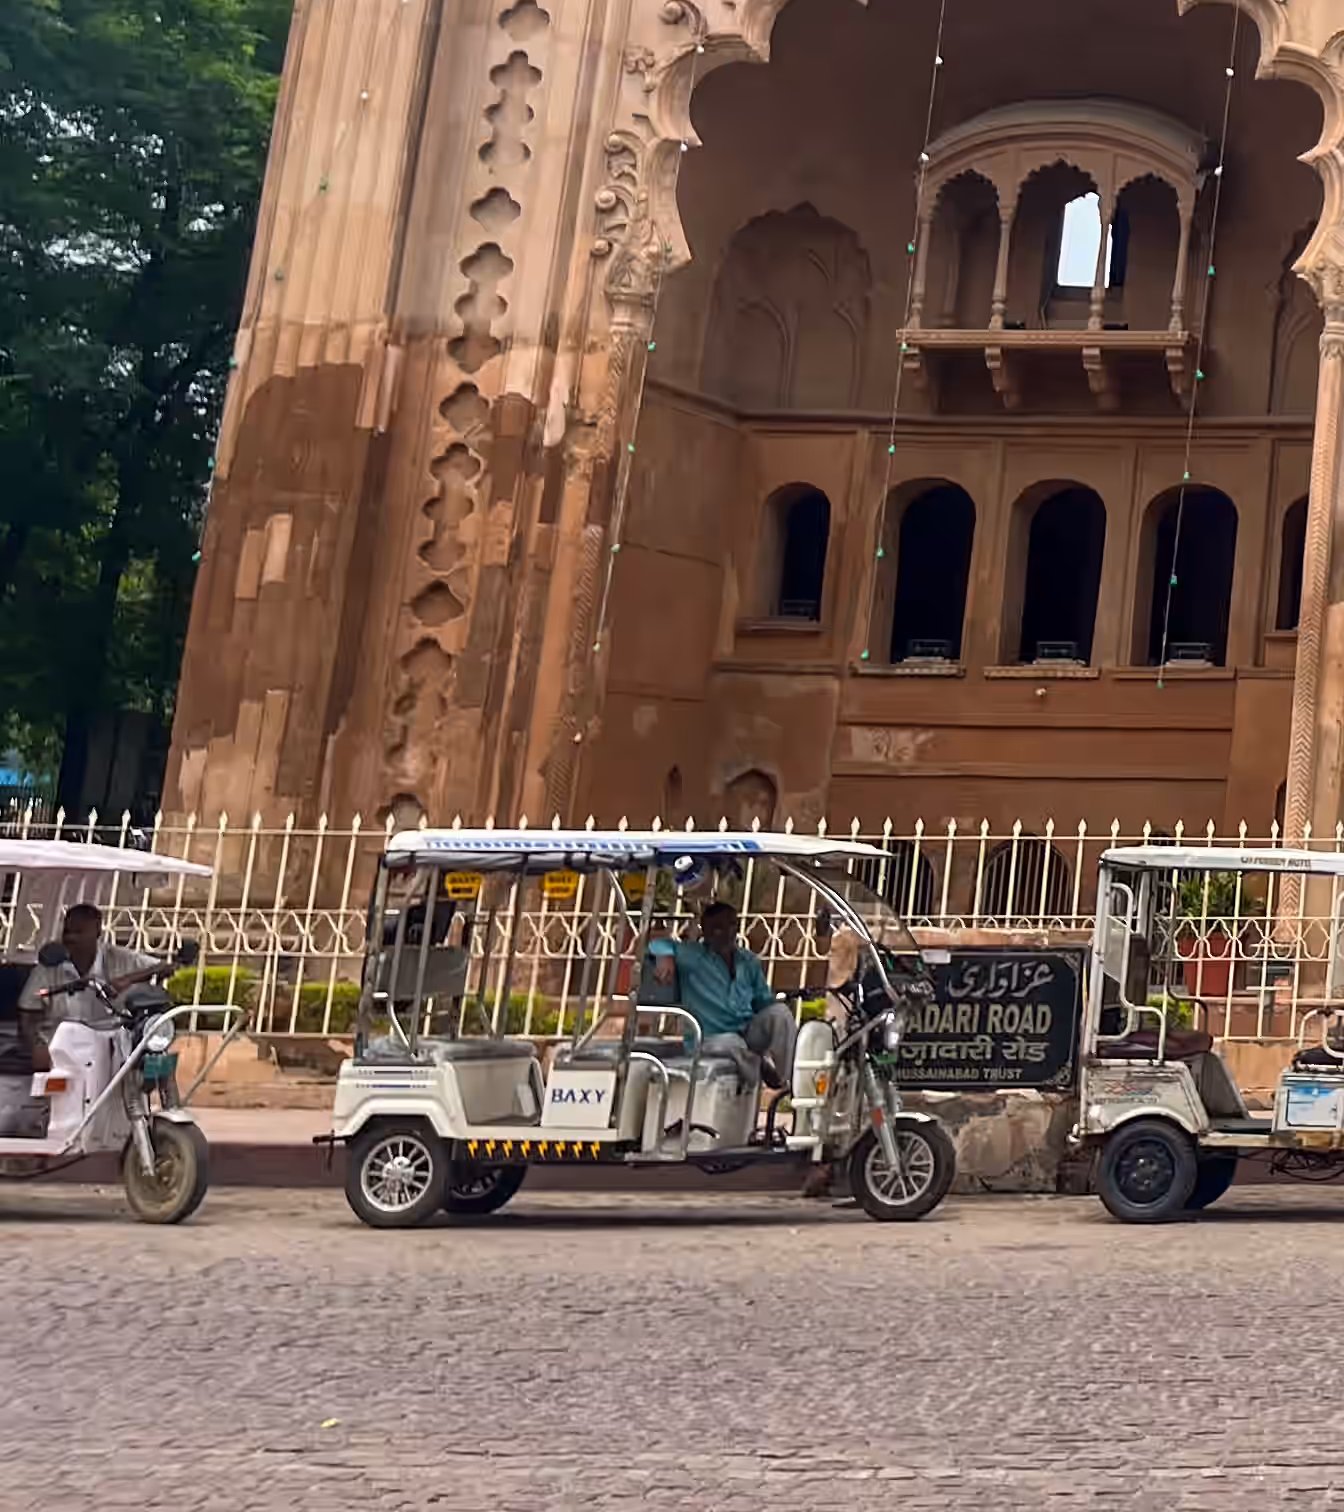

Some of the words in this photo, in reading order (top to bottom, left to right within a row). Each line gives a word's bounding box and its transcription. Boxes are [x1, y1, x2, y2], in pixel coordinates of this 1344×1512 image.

[906, 1002, 980, 1034] ADARI
[987, 1003, 1053, 1035] ROAD
[900, 1035, 995, 1066] ज़ादारी
[1001, 1035, 1051, 1063] रोड
[983, 1067, 1024, 1080] TRUST
[551, 1088, 606, 1104] BAXY
